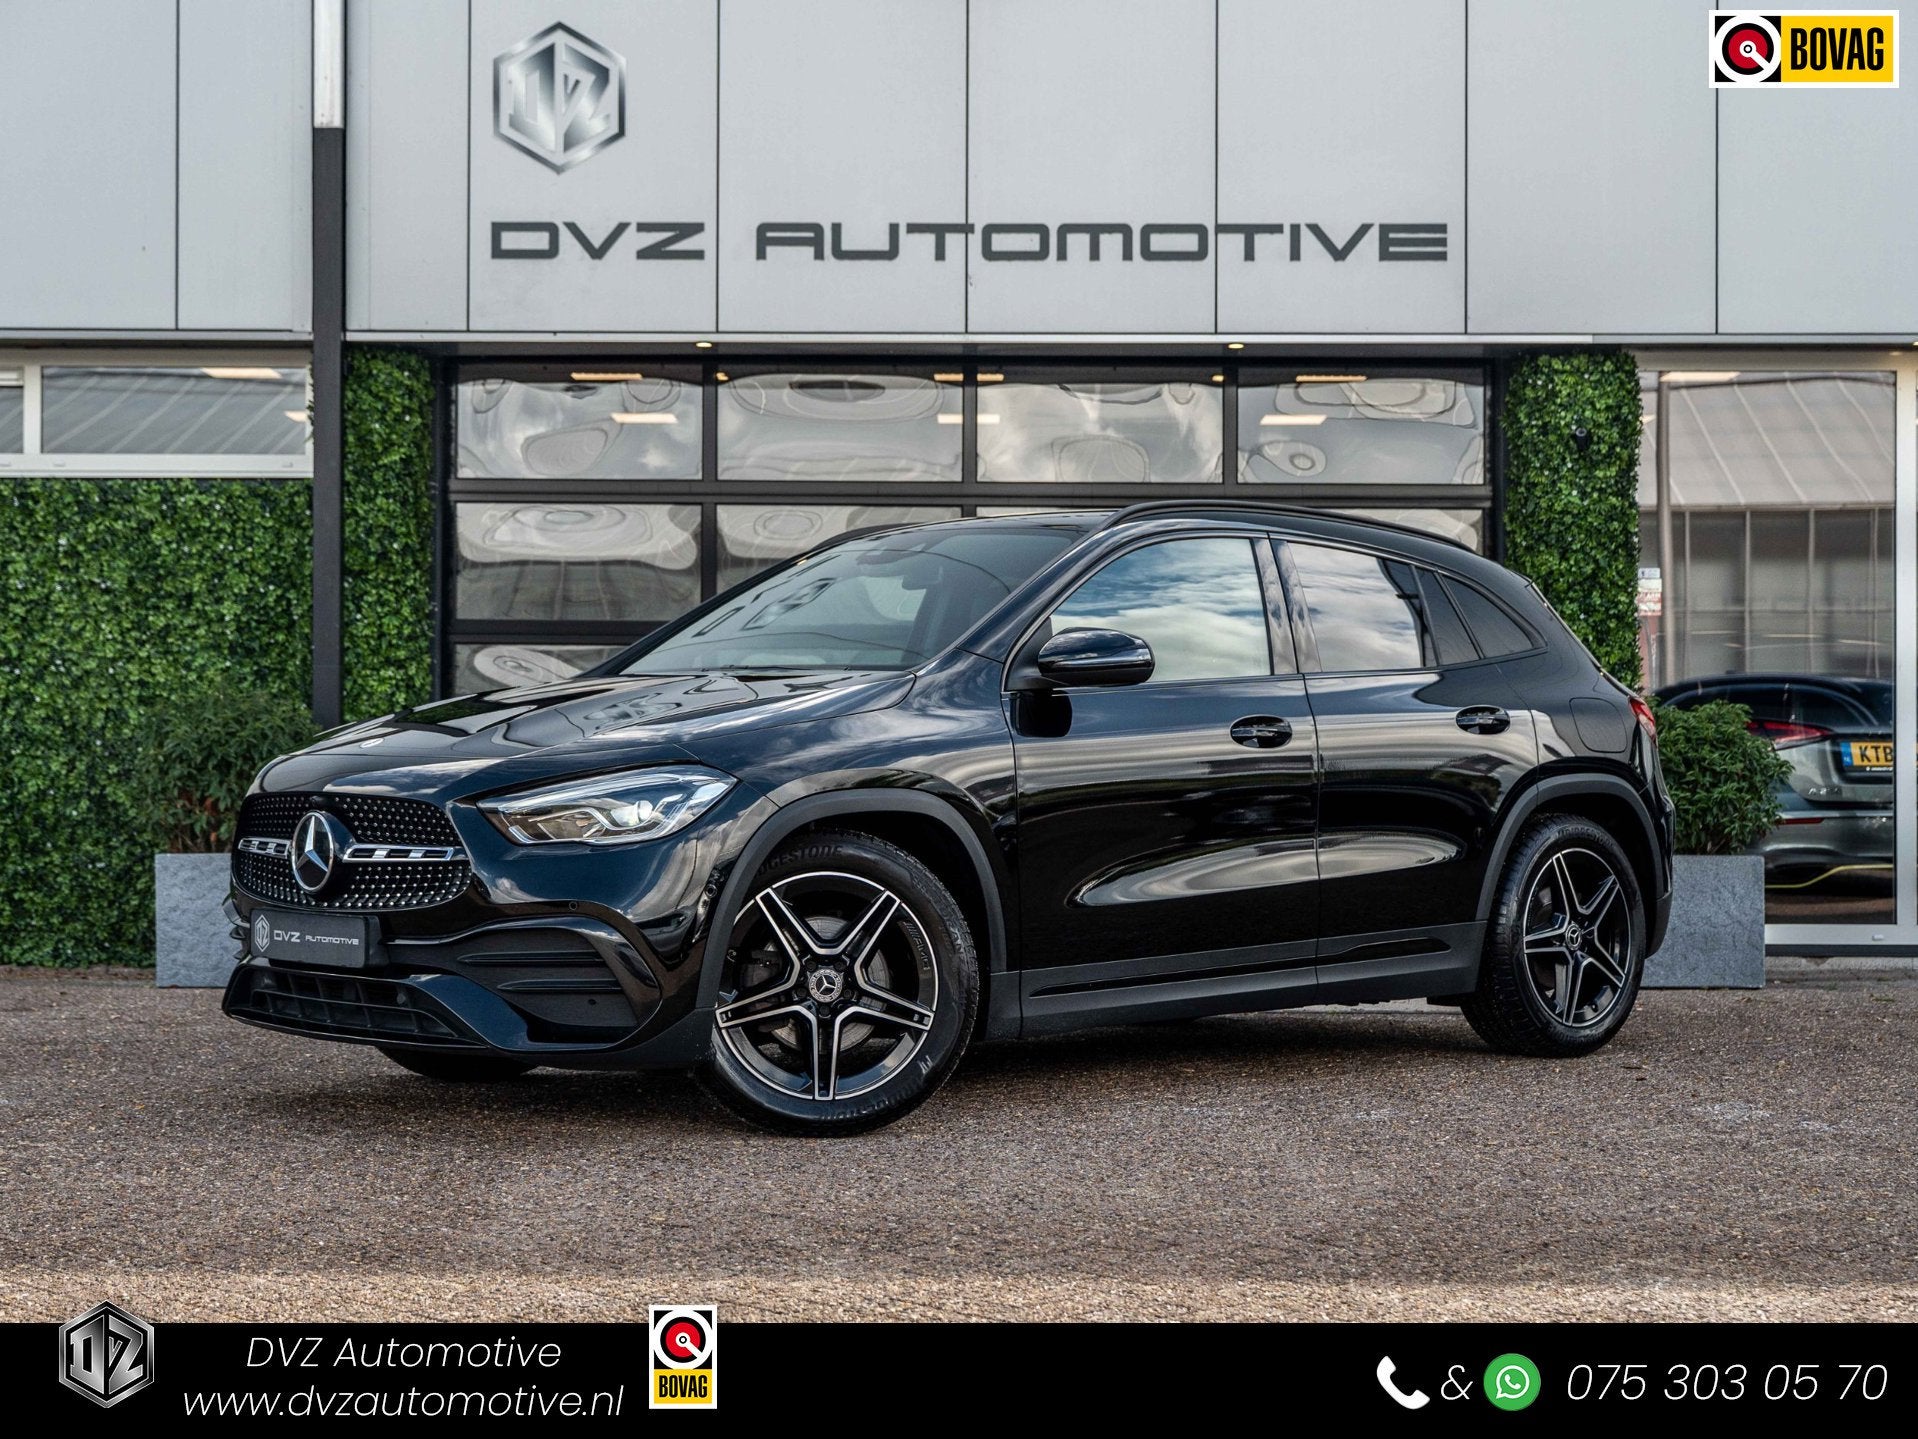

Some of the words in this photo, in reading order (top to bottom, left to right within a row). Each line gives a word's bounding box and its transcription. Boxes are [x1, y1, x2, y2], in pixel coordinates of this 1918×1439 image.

[491, 222, 705, 260] DVZ
[756, 222, 1448, 262] AUTOMOTIVE
[1859, 745, 1893, 763] KTB
[273, 929, 300, 943] DVZ
[305, 935, 360, 946] AUTOMOTIVE
